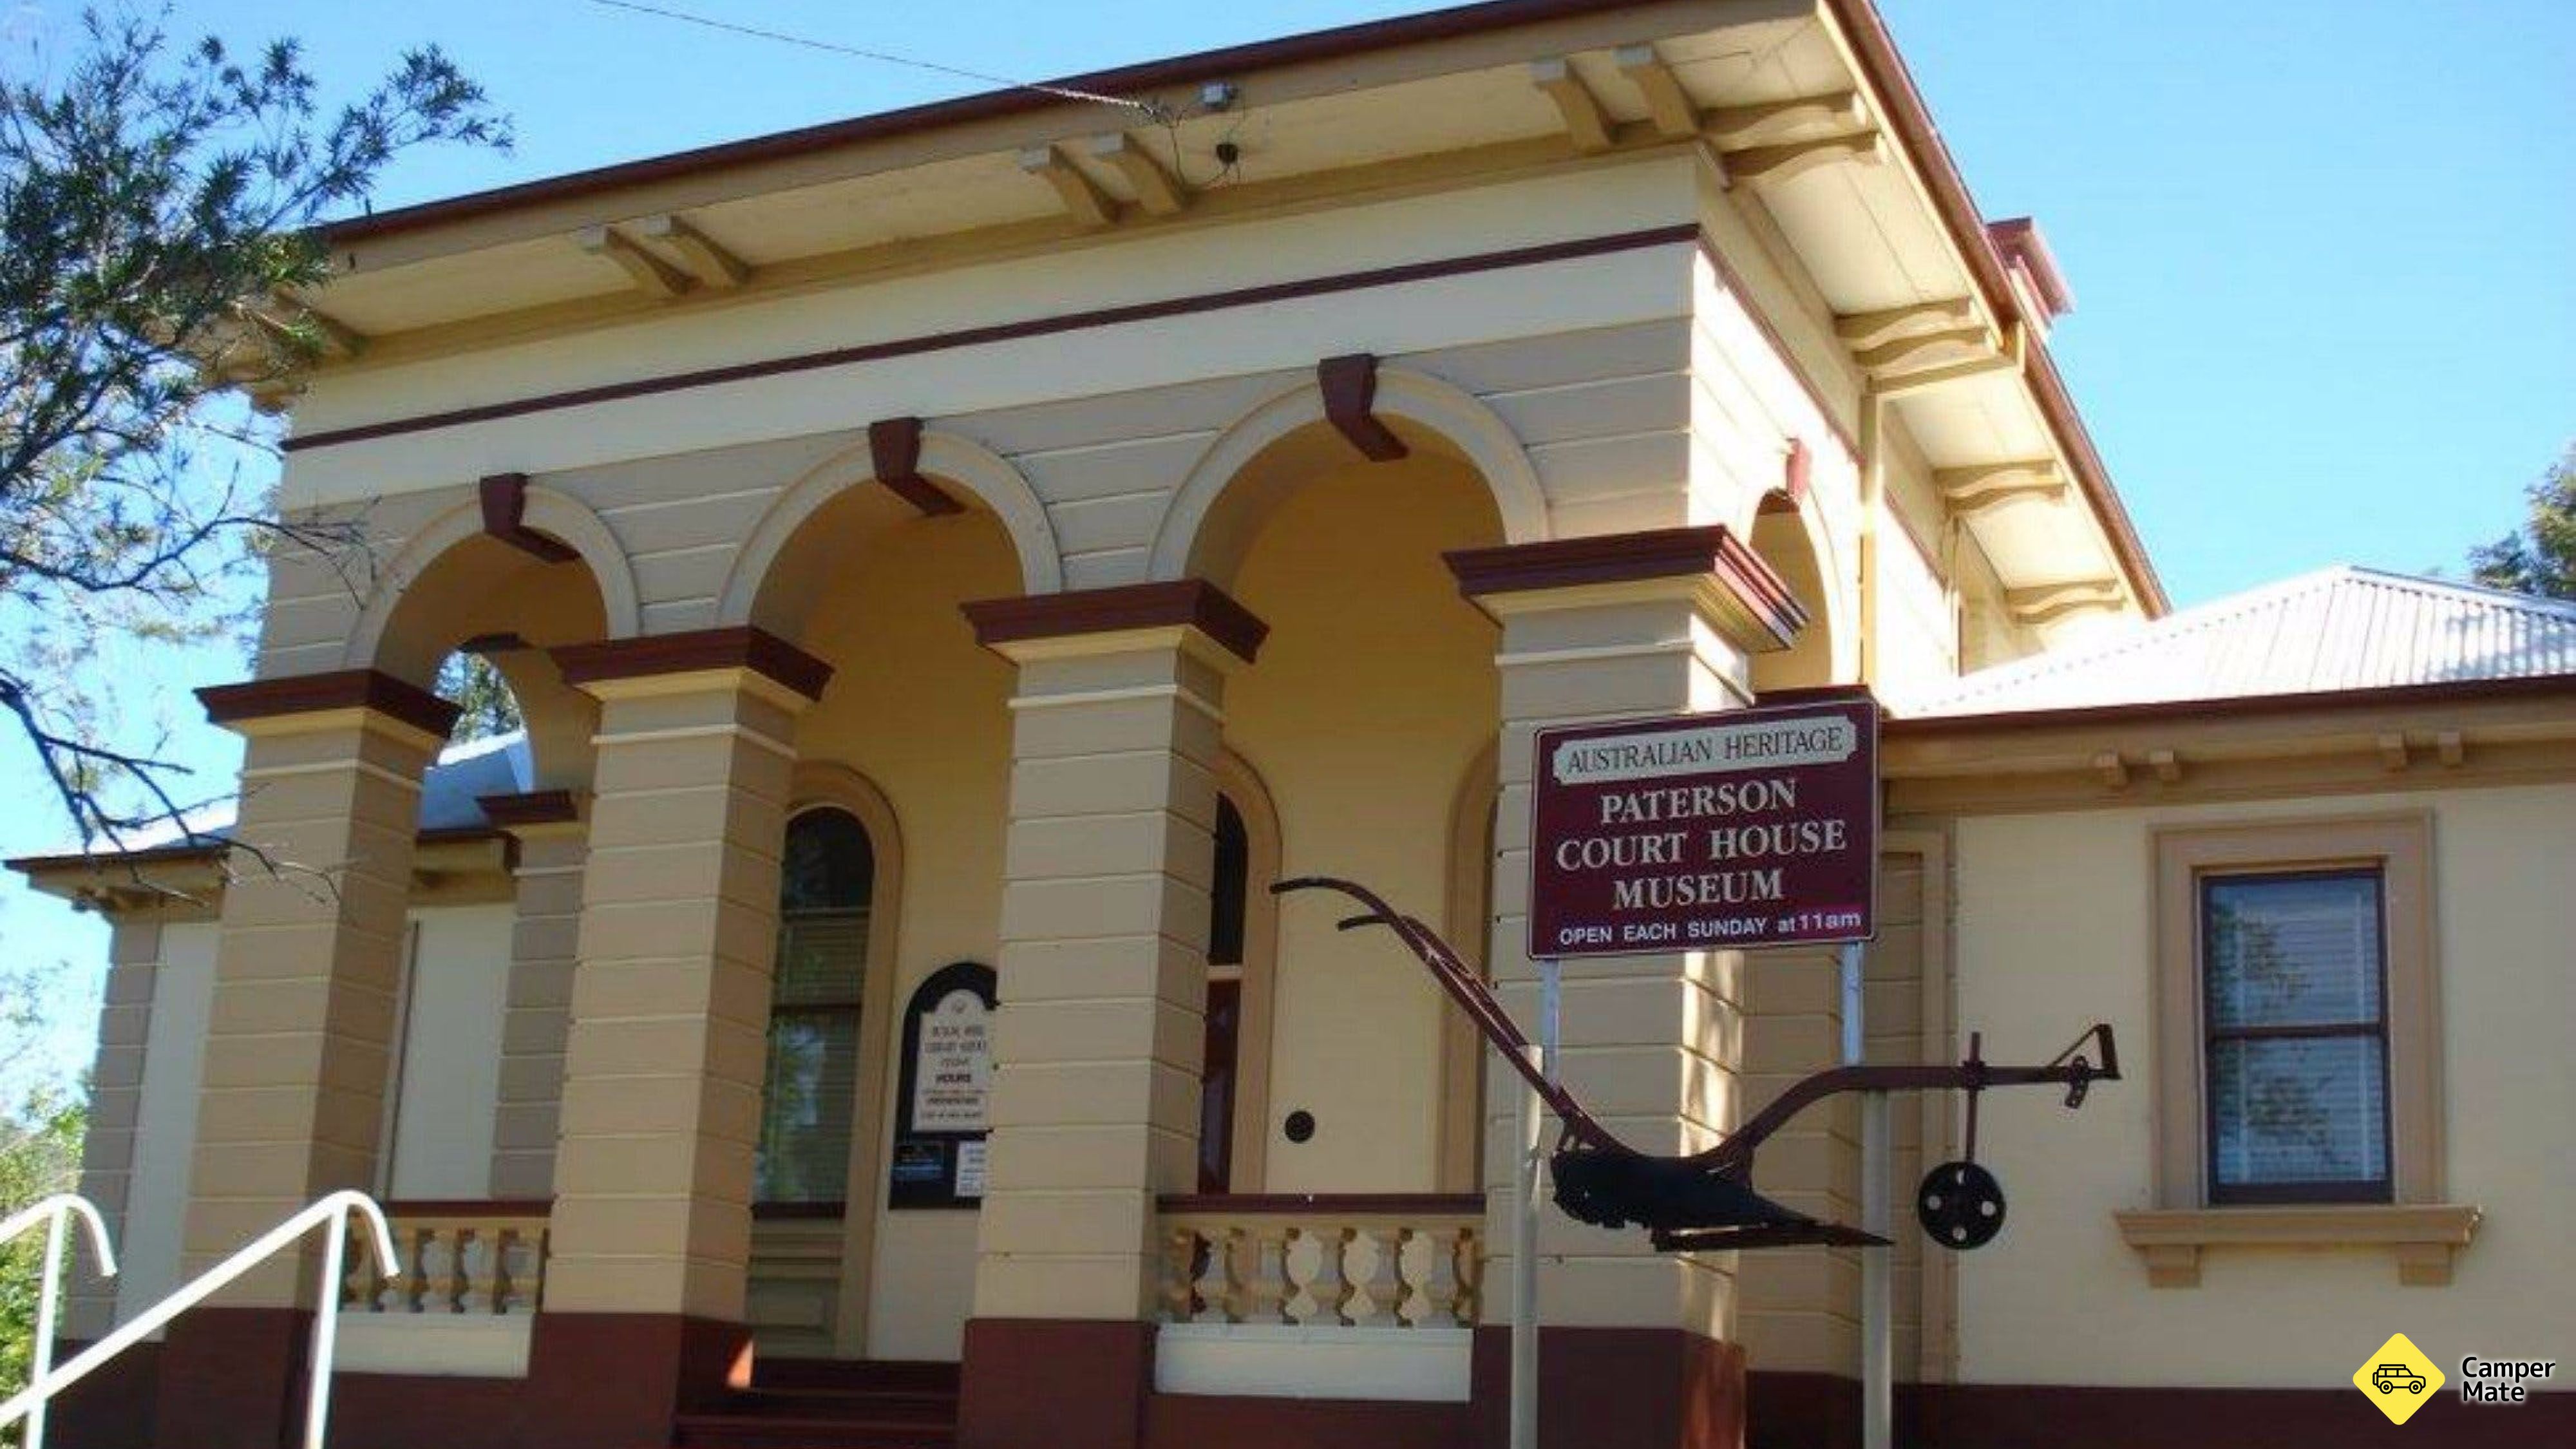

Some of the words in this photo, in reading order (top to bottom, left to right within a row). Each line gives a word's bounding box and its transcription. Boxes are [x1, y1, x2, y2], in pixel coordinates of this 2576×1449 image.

[1567, 738, 1713, 774] AUSTRALIAN
[1724, 726, 1844, 761] HERITAGE
[1601, 777, 1797, 825] PATERSON
[1556, 832, 1688, 871] COURT
[1709, 819, 1846, 860] HOUSE
[1612, 867, 1784, 911] MUSEUM
[1559, 924, 1612, 945] OPEN
[1624, 922, 1676, 942] EACH
[1687, 916, 1768, 938] SUNDAY
